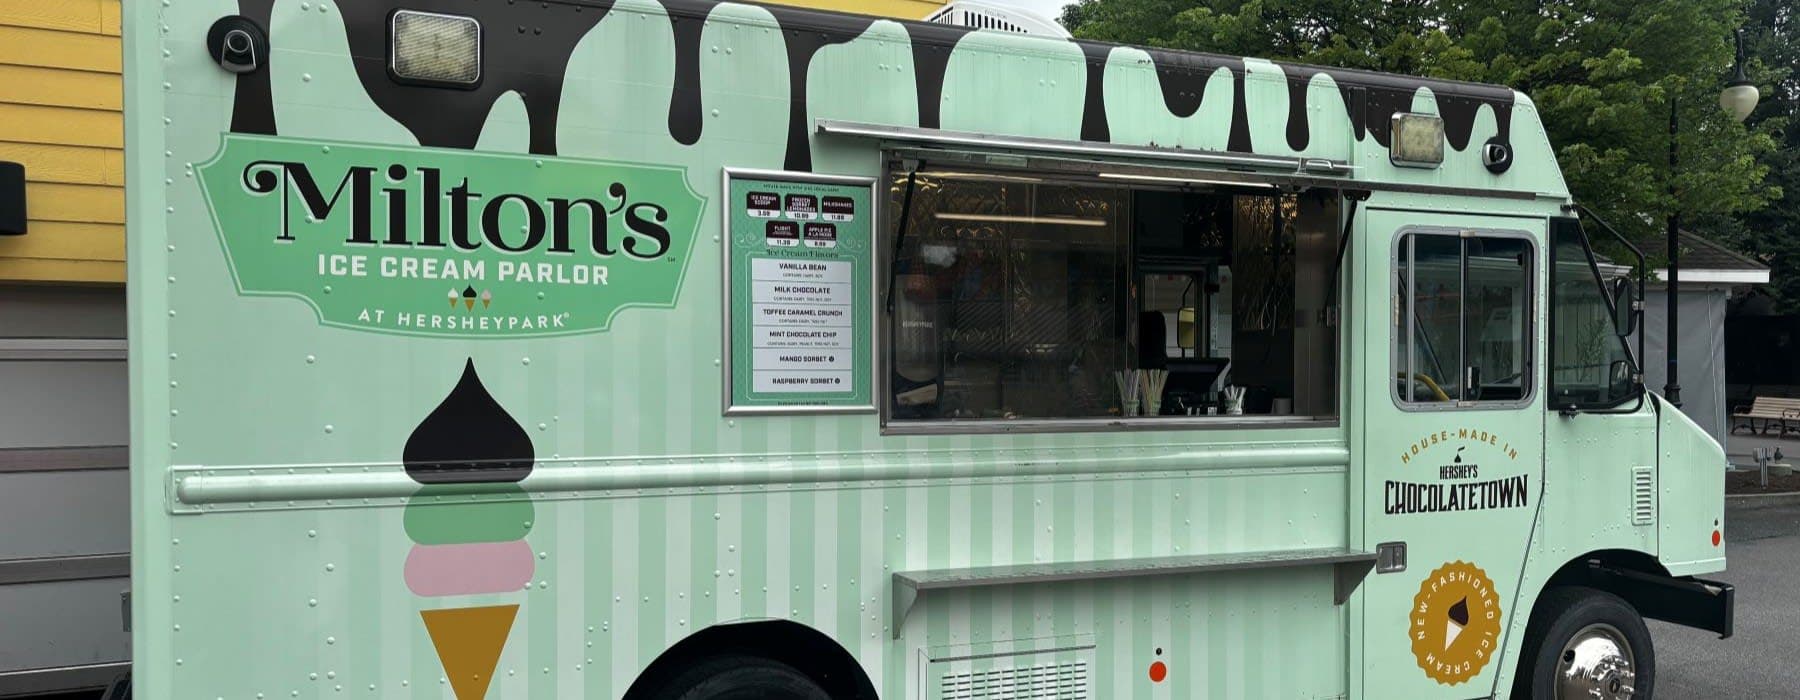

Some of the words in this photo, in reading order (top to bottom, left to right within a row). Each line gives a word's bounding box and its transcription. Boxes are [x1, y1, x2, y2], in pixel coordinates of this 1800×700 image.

[241, 160, 672, 259] Milton's
[318, 254, 367, 276] ICE
[380, 257, 485, 280] CREAM
[497, 260, 609, 285] PARLOR
[358, 309, 385, 323] AT
[1401, 428, 1497, 464] HOUSE-MADE
[1503, 443, 1518, 460] IN
[1439, 464, 1478, 480] HERSHEY'S
[1384, 474, 1528, 515] CHOCOLATETOWN
[1417, 572, 1494, 640] NEW-FASHIONED
[1475, 631, 1493, 659] ICE
[1426, 653, 1471, 674] CREAM
